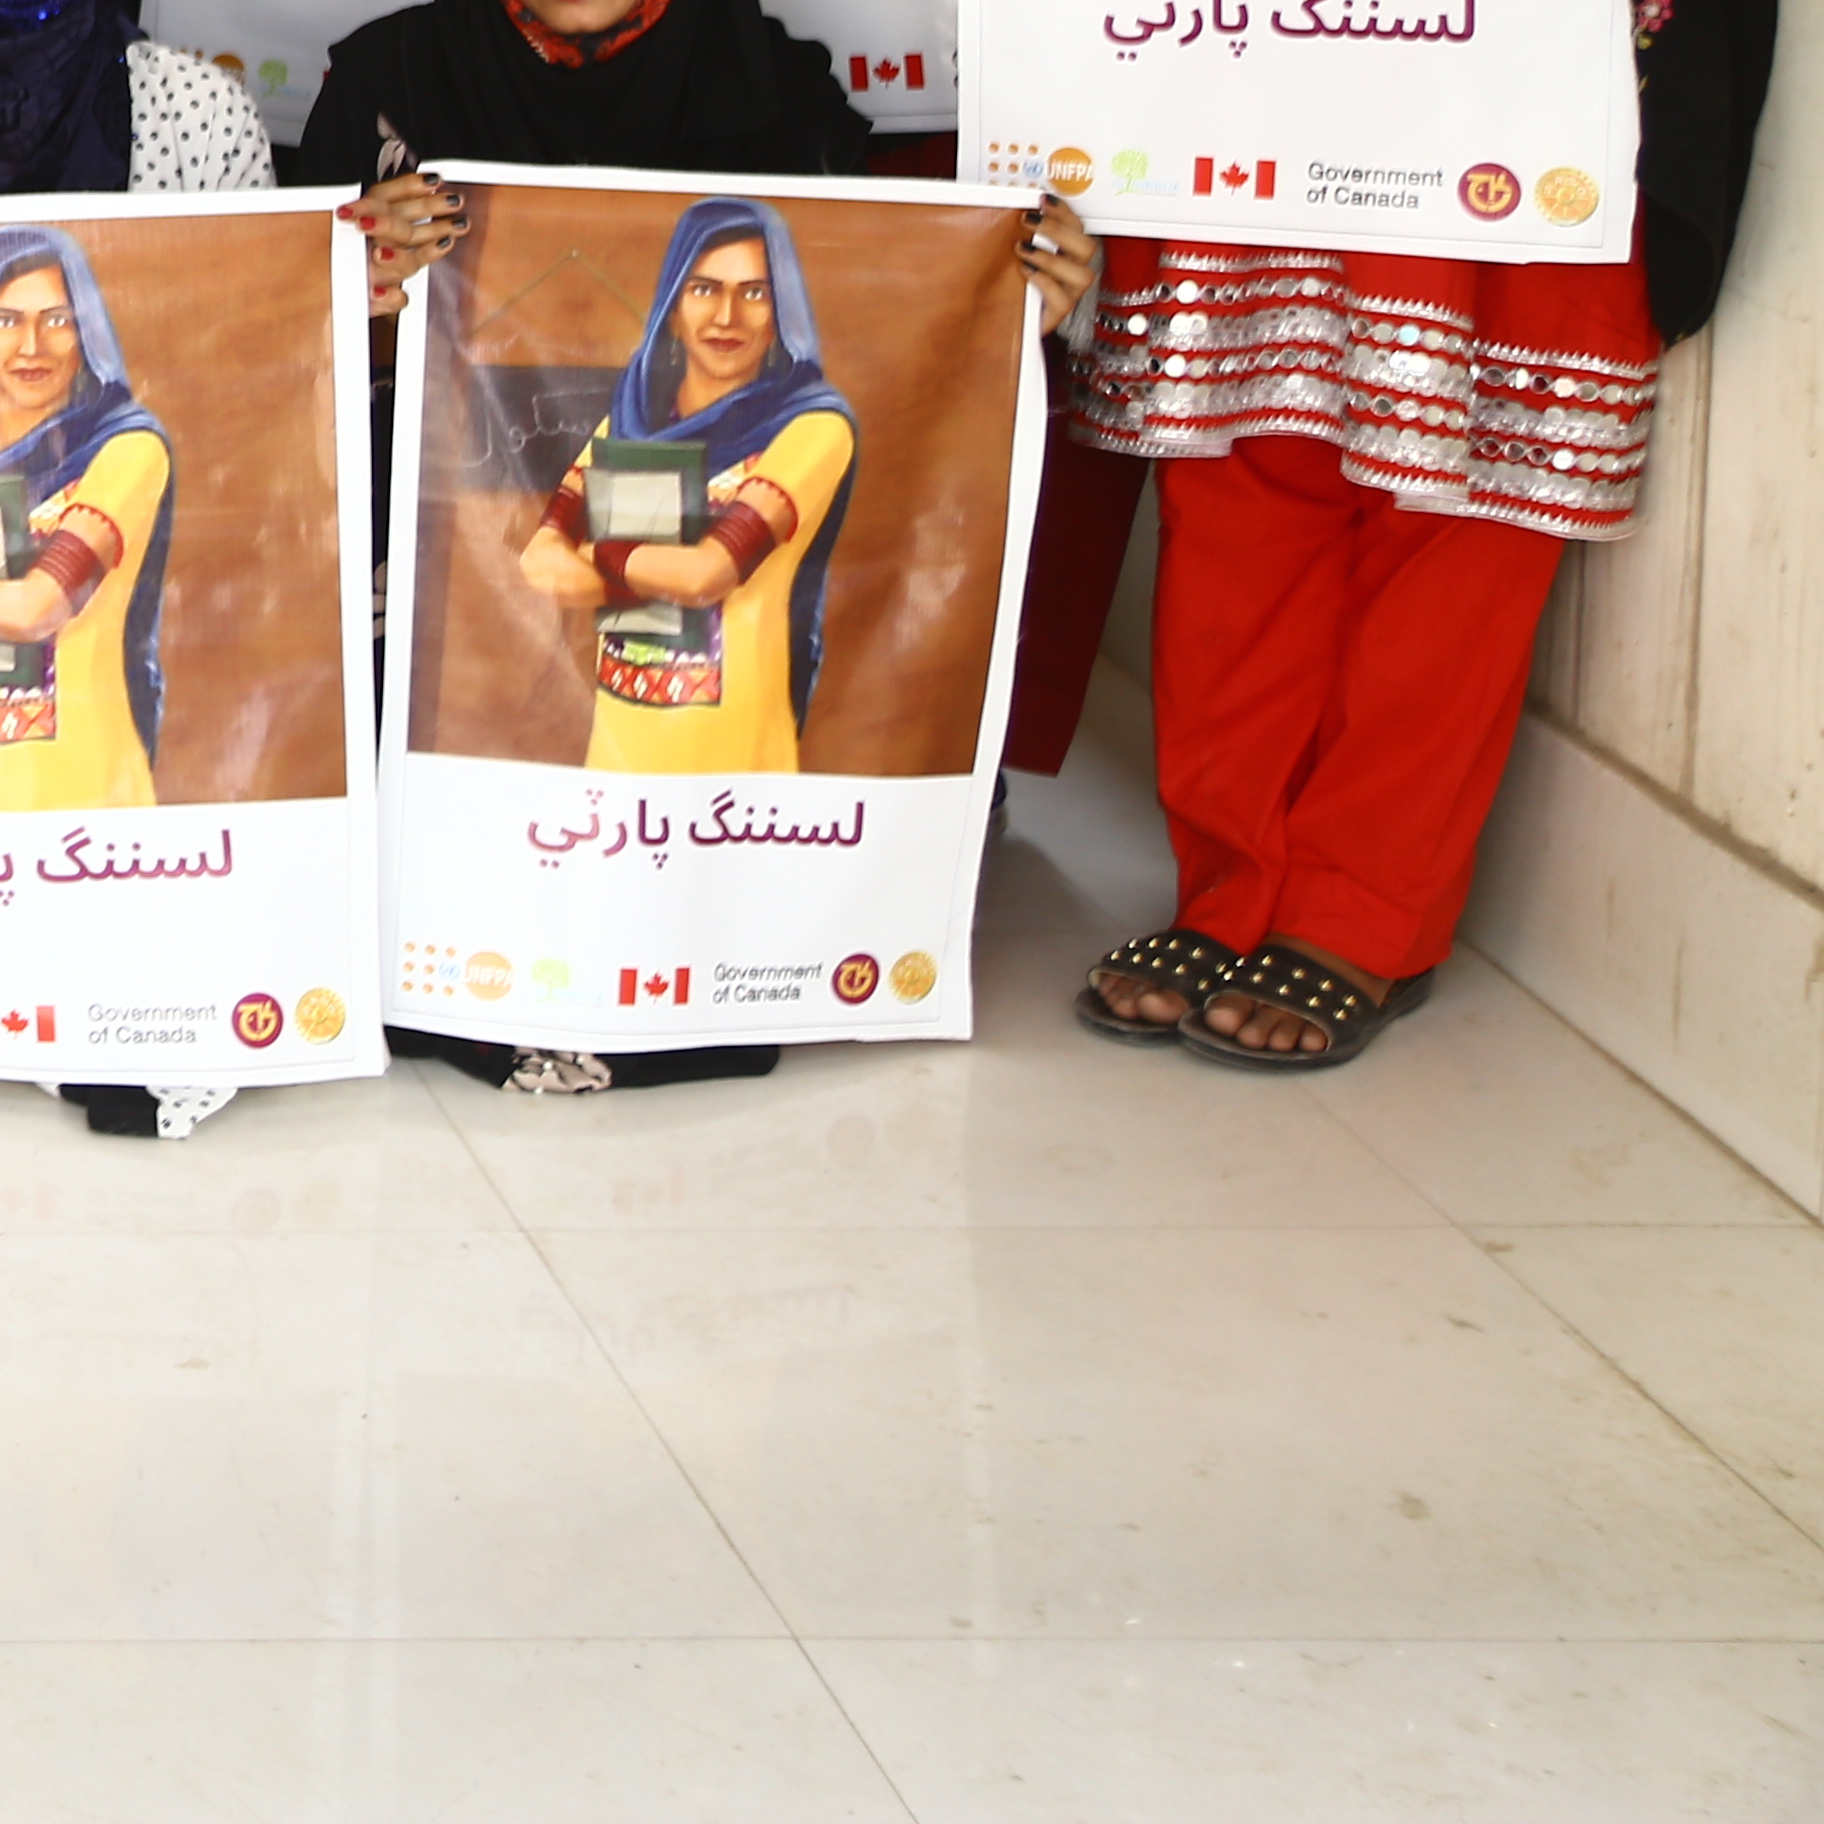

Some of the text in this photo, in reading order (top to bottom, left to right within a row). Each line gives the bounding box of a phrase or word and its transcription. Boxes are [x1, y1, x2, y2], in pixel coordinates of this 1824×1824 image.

[1308, 162, 1442, 187] Government
[1306, 184, 1419, 209] of Canada
[713, 961, 822, 982] Government
[712, 982, 800, 1004] of Canada
[88, 1003, 216, 1022] Government
[88, 1026, 196, 1044] of Canada
